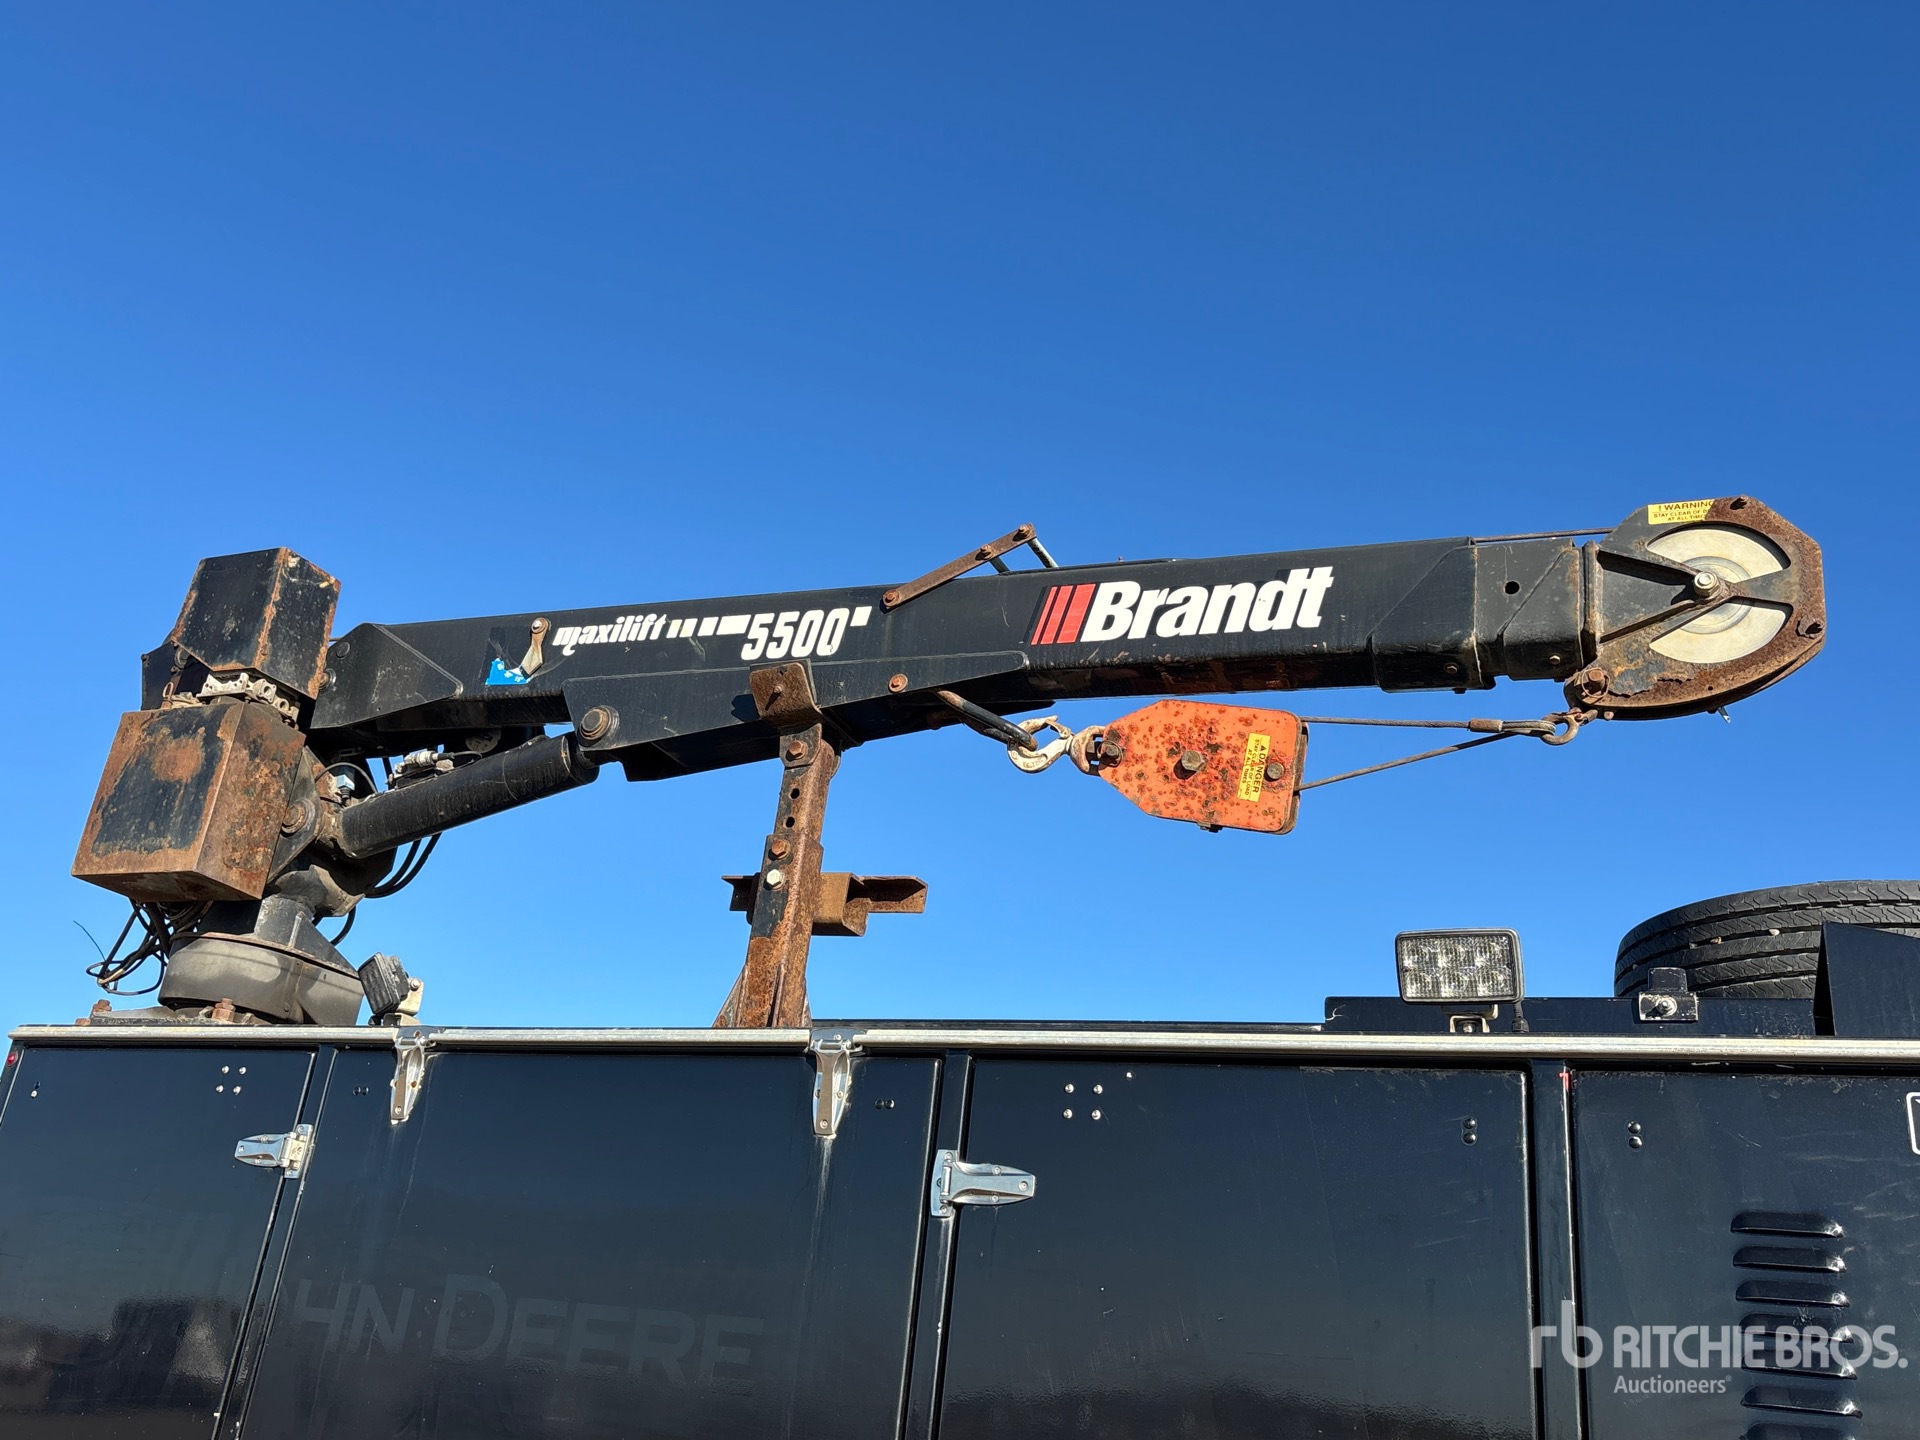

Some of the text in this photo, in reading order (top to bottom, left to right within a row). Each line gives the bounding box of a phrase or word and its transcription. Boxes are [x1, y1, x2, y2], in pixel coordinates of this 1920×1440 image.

[1080, 566, 1334, 643] Brandt
[552, 607, 850, 661] maxilift 5500
[1248, 771, 1254, 780] OF
[1252, 753, 1267, 793] DANGER
[431, 1273, 765, 1393] DEERE
